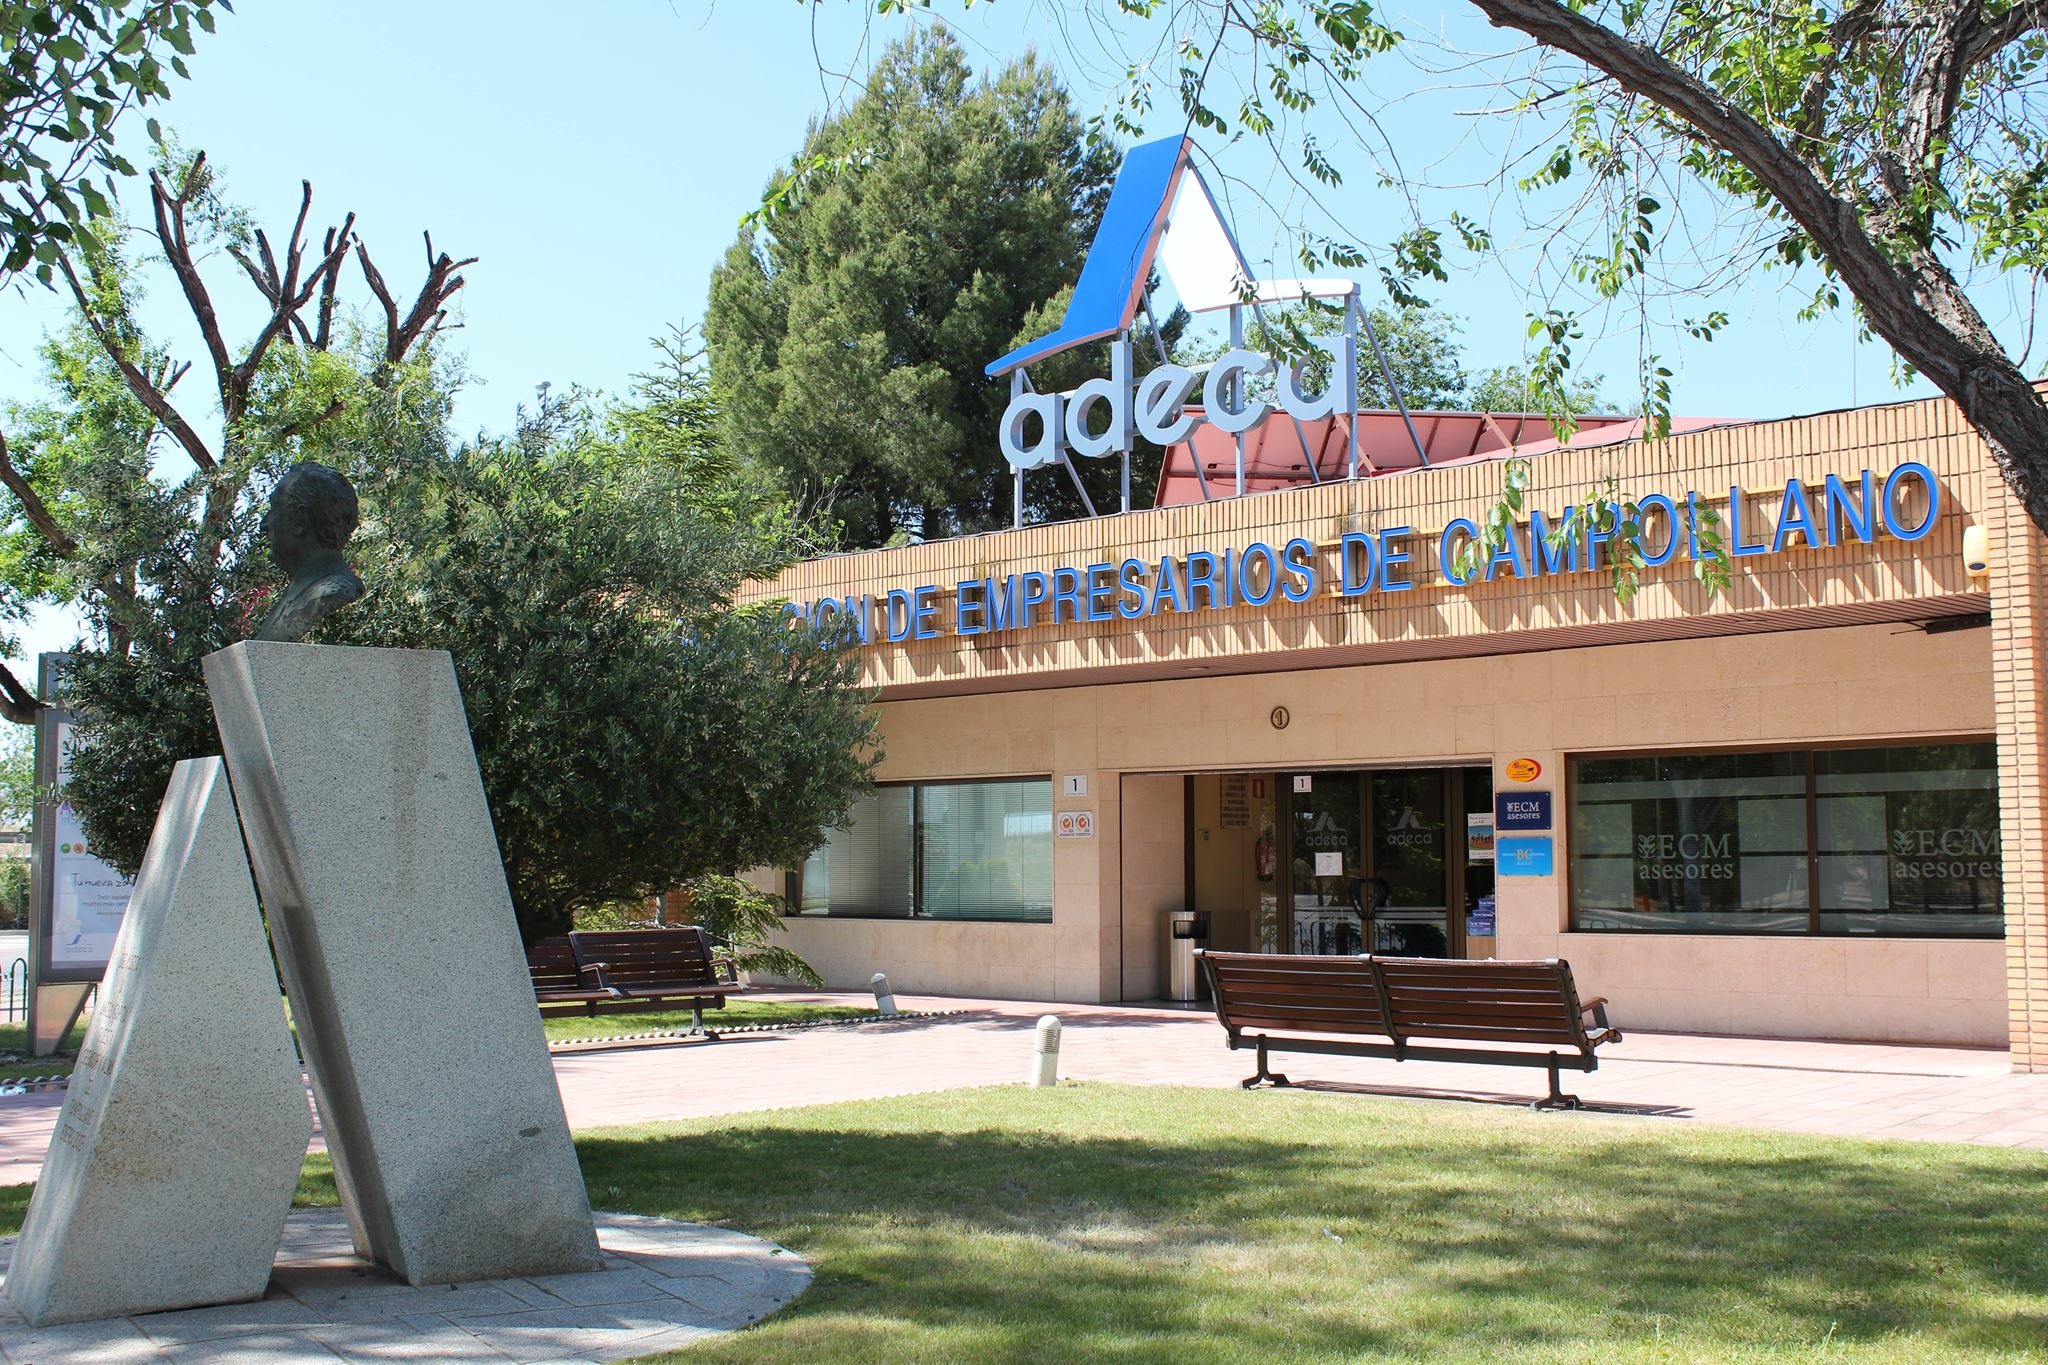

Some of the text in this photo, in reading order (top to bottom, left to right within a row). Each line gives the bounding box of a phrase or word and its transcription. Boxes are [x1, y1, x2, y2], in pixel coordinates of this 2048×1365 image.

[999, 336, 1350, 470] adeca
[887, 585, 937, 642] DE
[957, 537, 1315, 635] EMPRESARIOS
[1341, 526, 1412, 596] DE
[1439, 461, 1939, 587] CAMPOLLANO
[1274, 710, 1283, 726] 1
[1072, 778, 1077, 792] 1
[1513, 801, 1540, 812] ECM
[1507, 812, 1540, 820] asesores
[1305, 834, 1348, 846] adeca
[1387, 832, 1433, 845] adeca
[1656, 833, 1733, 860] ECM
[1914, 828, 2001, 857] ECM
[1639, 862, 1734, 880] asesores
[1895, 860, 2002, 879] asesores
[71, 872, 83, 887] Tu
[85, 879, 113, 887] nueva
